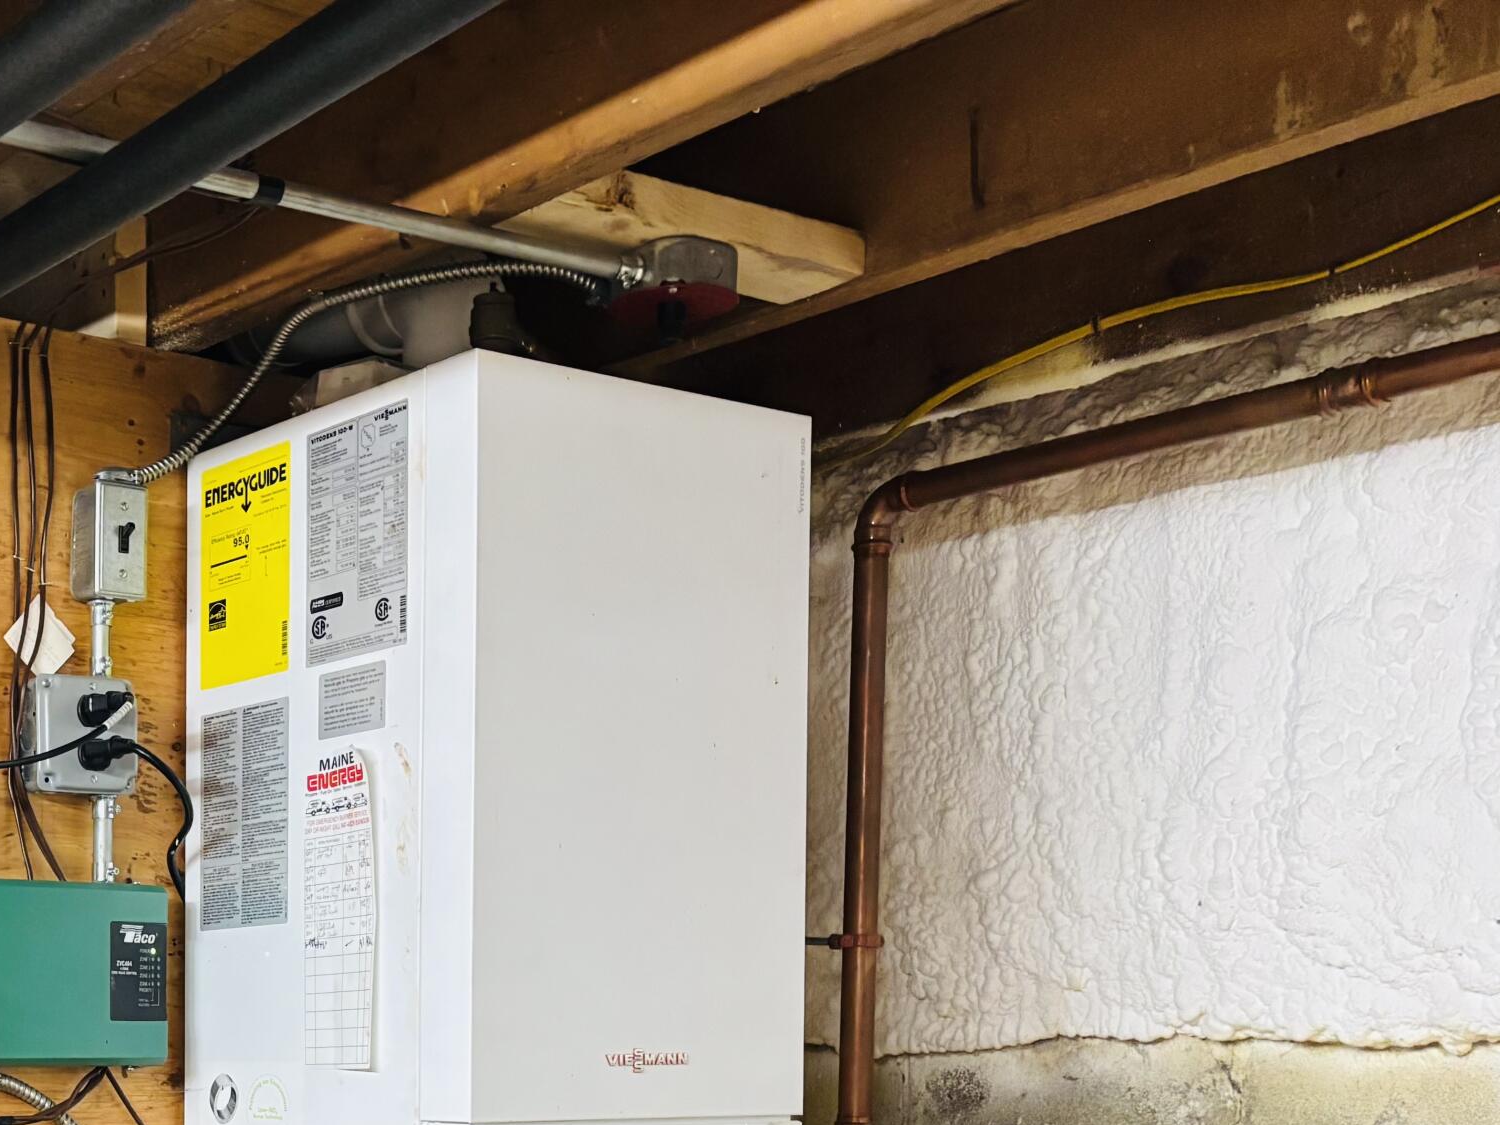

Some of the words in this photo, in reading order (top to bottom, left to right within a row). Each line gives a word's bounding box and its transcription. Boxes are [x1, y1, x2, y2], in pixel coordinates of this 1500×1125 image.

[205, 463, 286, 509] ENERGYGUIDE
[233, 534, 250, 547] 95.0
[319, 751, 354, 772] MAINE
[307, 763, 364, 792] ENERGY
[119, 924, 156, 944] Taco
[605, 1048, 689, 1073] VIESSMANN
